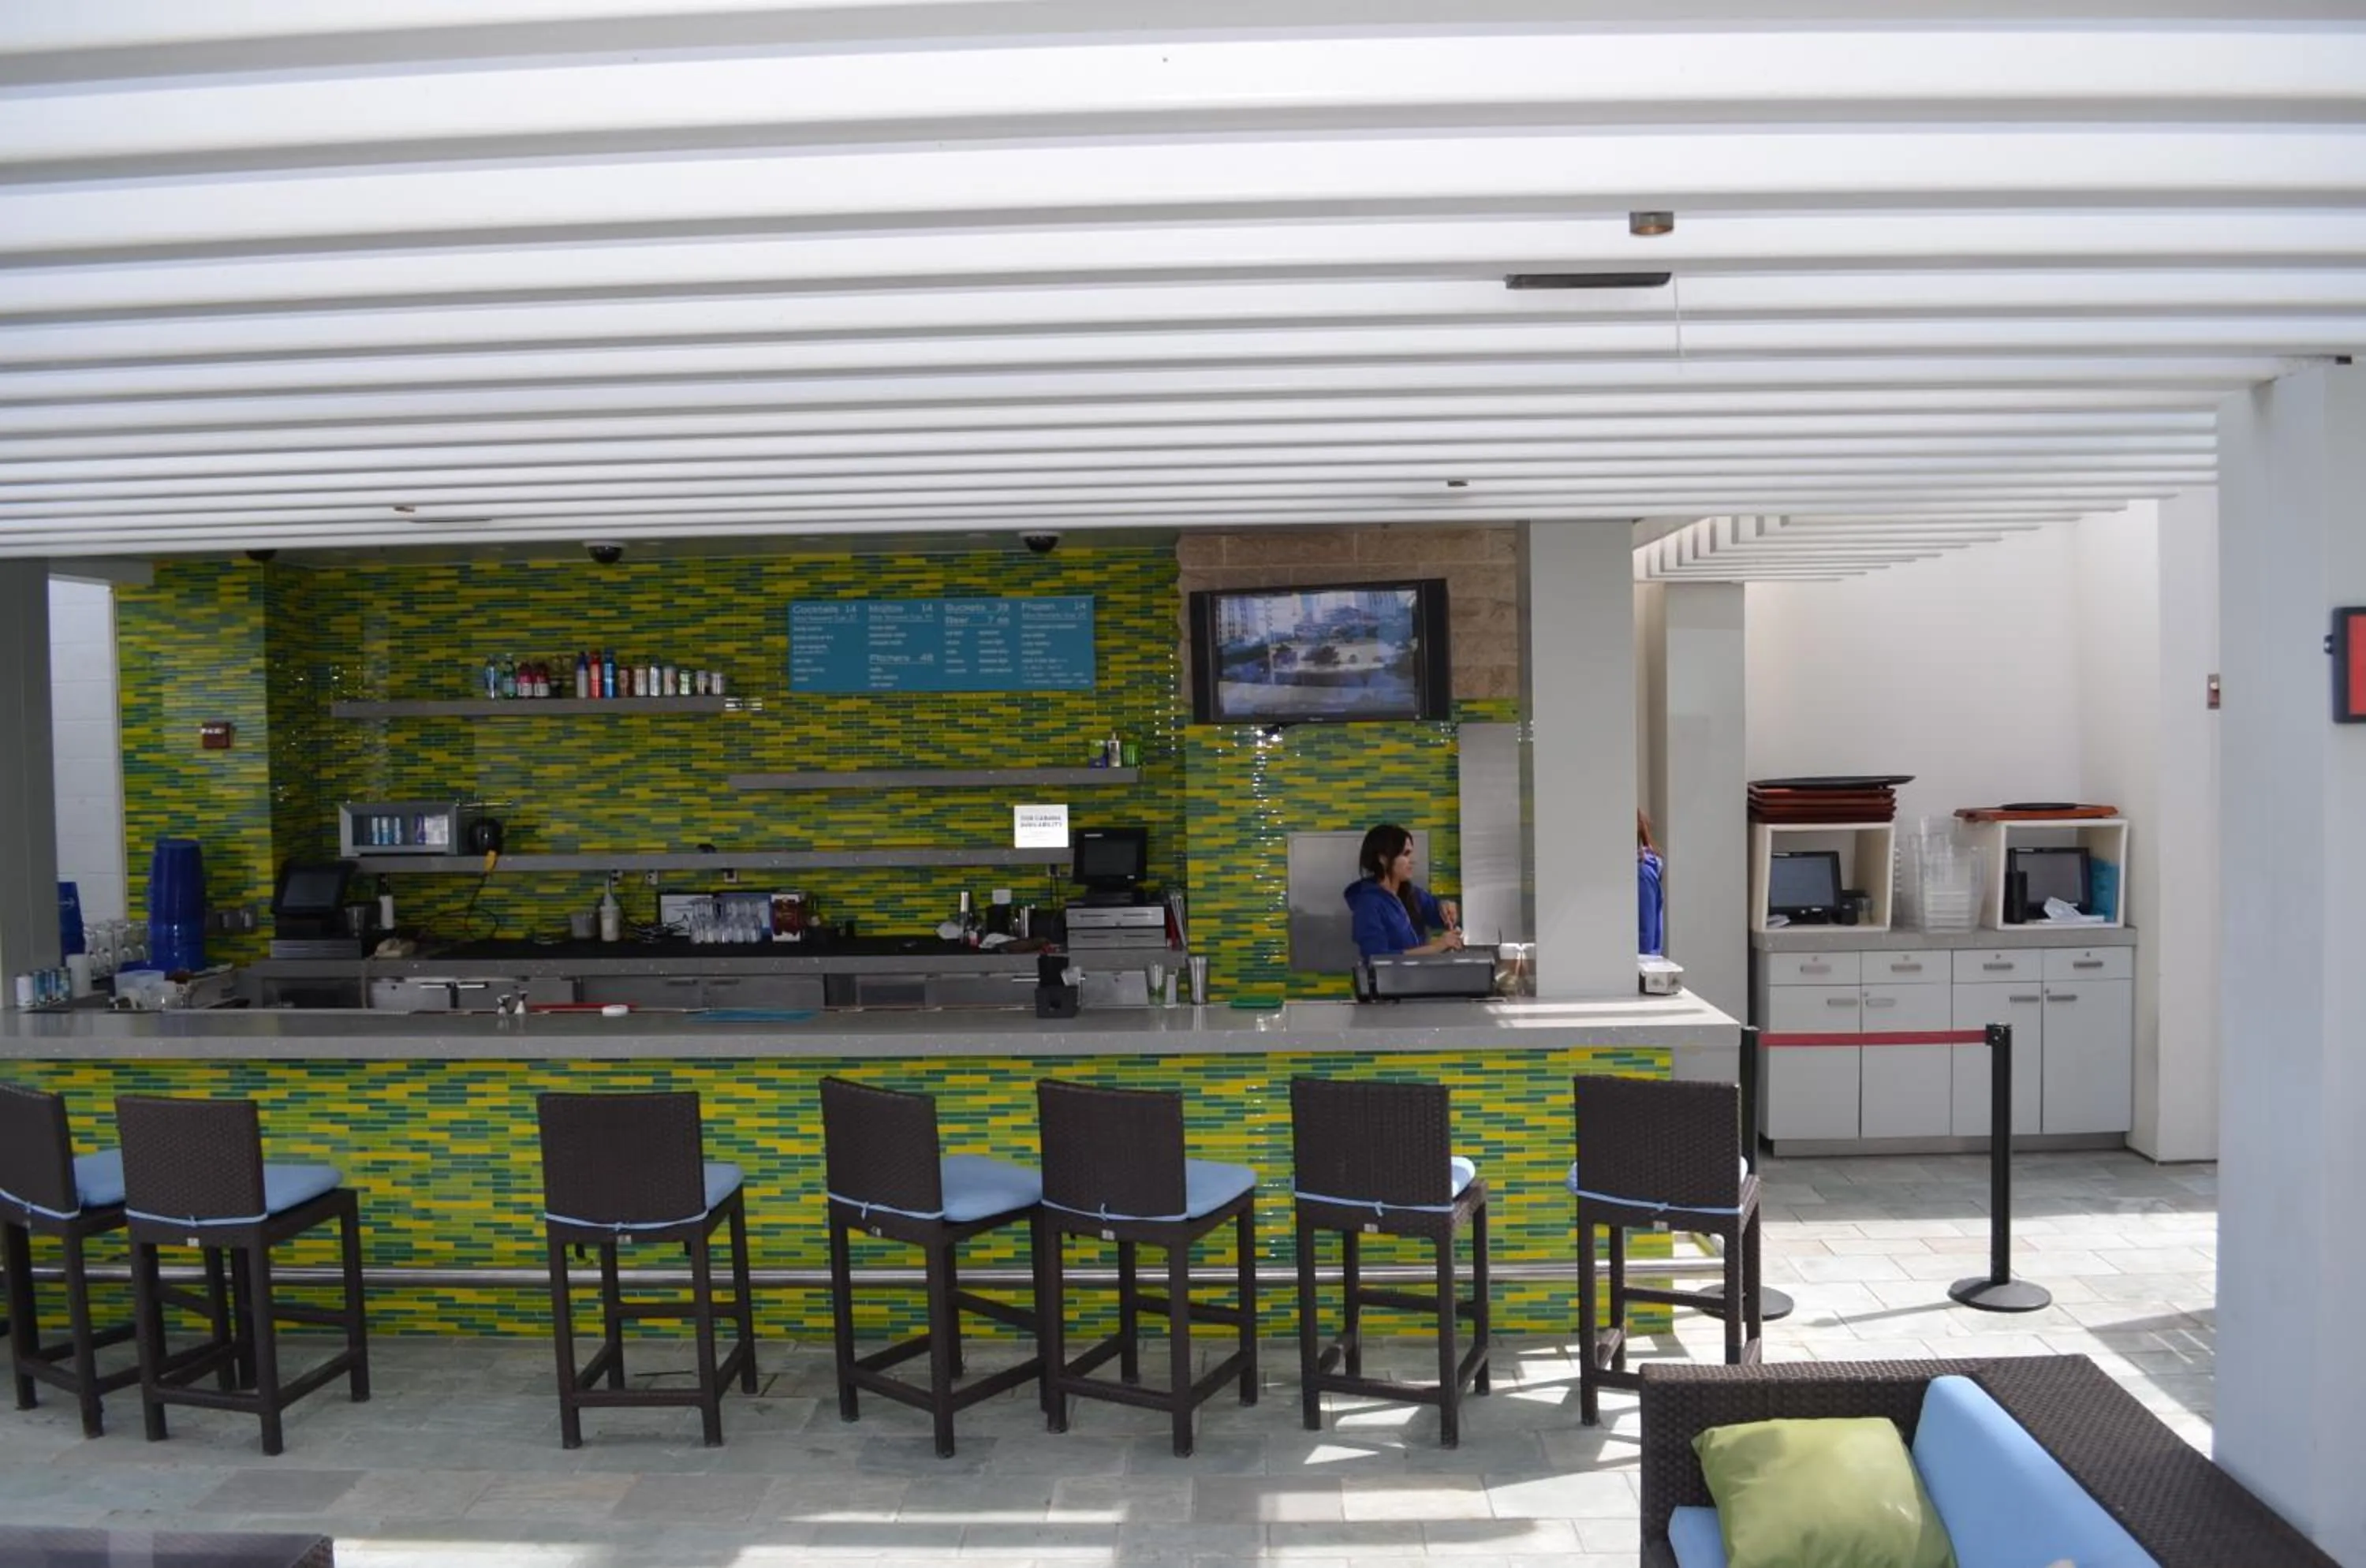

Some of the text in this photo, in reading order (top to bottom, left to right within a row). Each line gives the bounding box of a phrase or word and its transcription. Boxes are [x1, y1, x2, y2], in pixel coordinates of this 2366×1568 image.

[793, 604, 839, 614] Cocktails
[1021, 601, 1056, 610] Frozen
[869, 653, 910, 663] Pitchers
